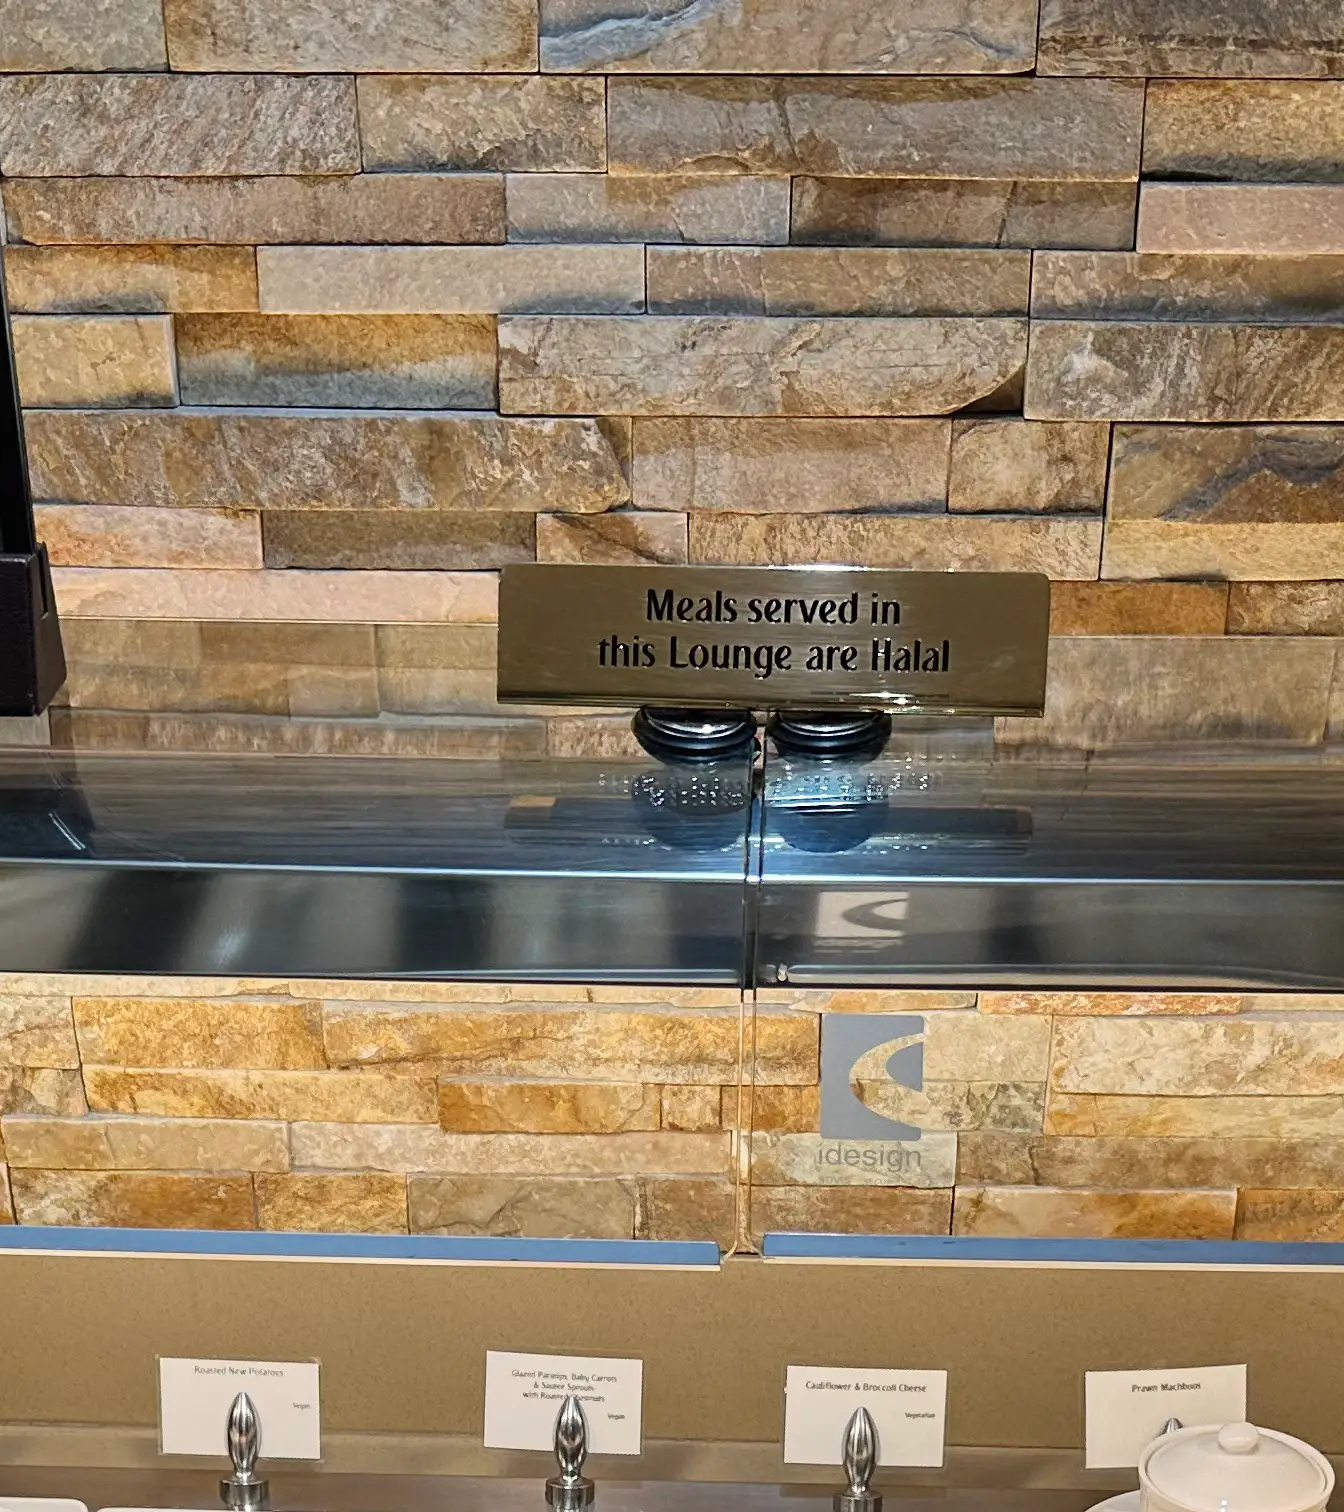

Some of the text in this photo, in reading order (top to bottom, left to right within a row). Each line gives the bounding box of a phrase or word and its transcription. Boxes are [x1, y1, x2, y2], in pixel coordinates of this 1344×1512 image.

[646, 588, 901, 626] Meals served in
[598, 634, 950, 679] this Lounge are Halal
[817, 1143, 922, 1173] idesign
[194, 1365, 284, 1378] Roasted New Potatoes
[805, 1380, 927, 1393] Cauliflower & Broccoli Cheese
[1131, 1382, 1201, 1393] Prawn Machboos
